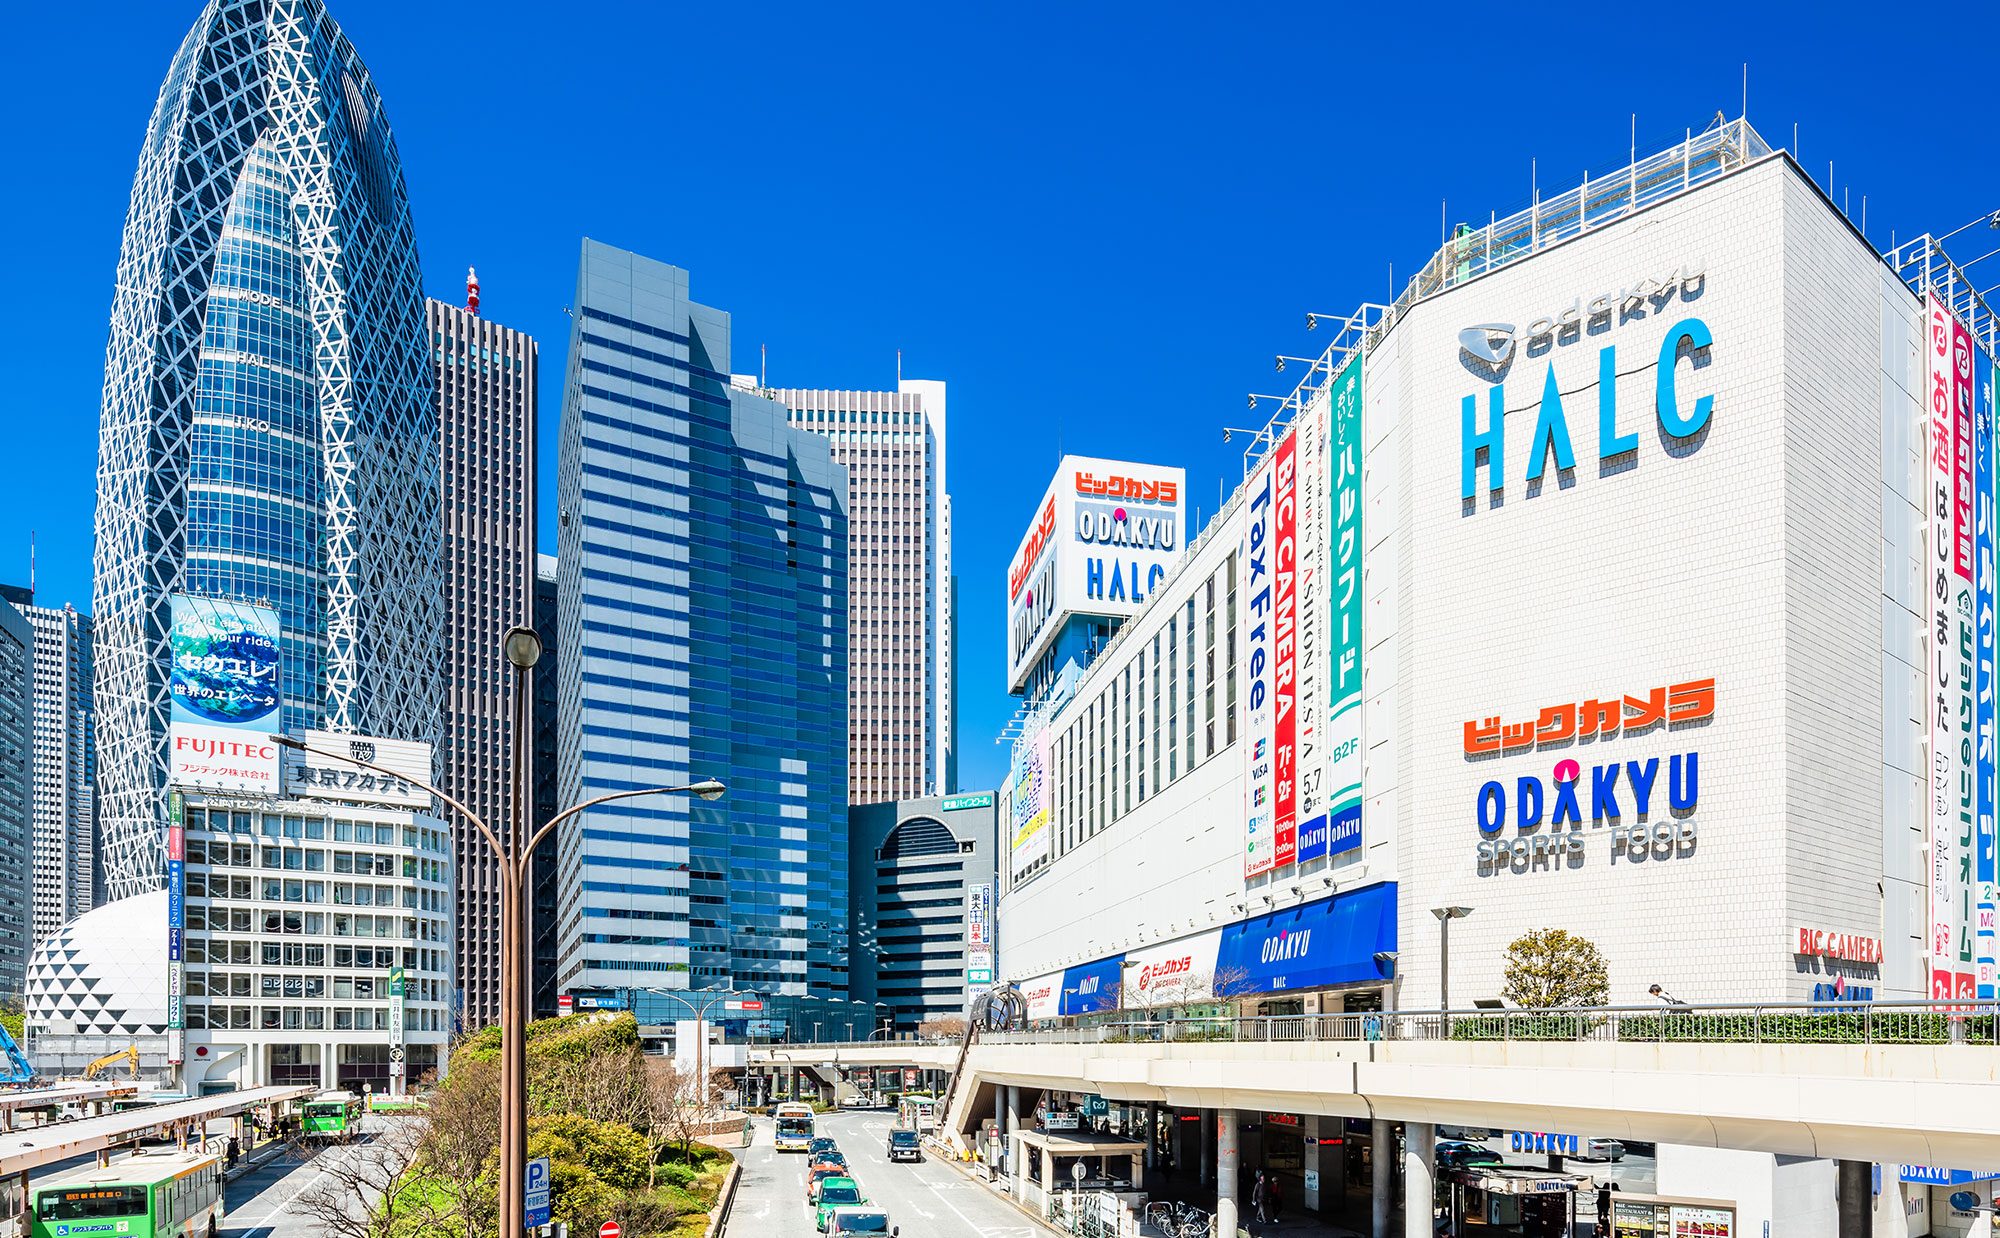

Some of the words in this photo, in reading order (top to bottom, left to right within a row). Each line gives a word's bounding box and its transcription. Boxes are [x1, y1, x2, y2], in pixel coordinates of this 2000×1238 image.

[238, 288, 282, 310] MODE
[1526, 258, 1706, 340] odakyu
[236, 352, 270, 369] HAL
[1462, 318, 1714, 500] HALC
[1075, 471, 1176, 503] ビックカメラ
[1957, 382, 1971, 571] ビックカメラ
[1277, 451, 1294, 532] BIC
[1079, 508, 1173, 548] ODAKYU
[1250, 472, 1271, 586] Tax
[1011, 492, 1055, 601] ビックカメラ
[1087, 557, 1164, 604] HALC
[1338, 444, 1355, 689] ハルクフード
[176, 611, 216, 627] World
[1013, 560, 1055, 663] ODAKYU
[1304, 549, 1314, 670] FASHION
[175, 624, 212, 639] Love
[212, 632, 242, 647] your
[1276, 536, 1294, 724] CAMERA
[1250, 585, 1270, 712] Free
[173, 684, 276, 707] 世界のエレベータ
[1303, 675, 1314, 759] FESTA
[1464, 677, 1715, 754] ビックカメラ
[177, 736, 274, 759] FUJITEC
[1278, 744, 1292, 769] 7F
[1333, 737, 1358, 763] B2F
[179, 763, 271, 781] フジテック株式会社
[1252, 763, 1268, 780] VISA
[1303, 768, 1321, 795] 5.7
[1278, 780, 1292, 803] 2F
[1477, 752, 1698, 833] ODAKYU
[1300, 828, 1325, 850] ODAKYU
[1332, 818, 1360, 842] ODAKYU
[1476, 831, 1585, 866] SPORTS
[1611, 819, 1698, 856] FOOD
[1262, 929, 1310, 964] ODAKYU
[1800, 927, 1824, 957] BIC
[1827, 932, 1884, 964] CAMERA
[1152, 956, 1192, 977] ビックカメラ
[263, 978, 314, 989] コンタクト
[1512, 1131, 1578, 1152] ODAKYU
[529, 1164, 543, 1189] P
[535, 1179, 547, 1188] 24H
[1900, 1164, 1949, 1180] ODAKYU
